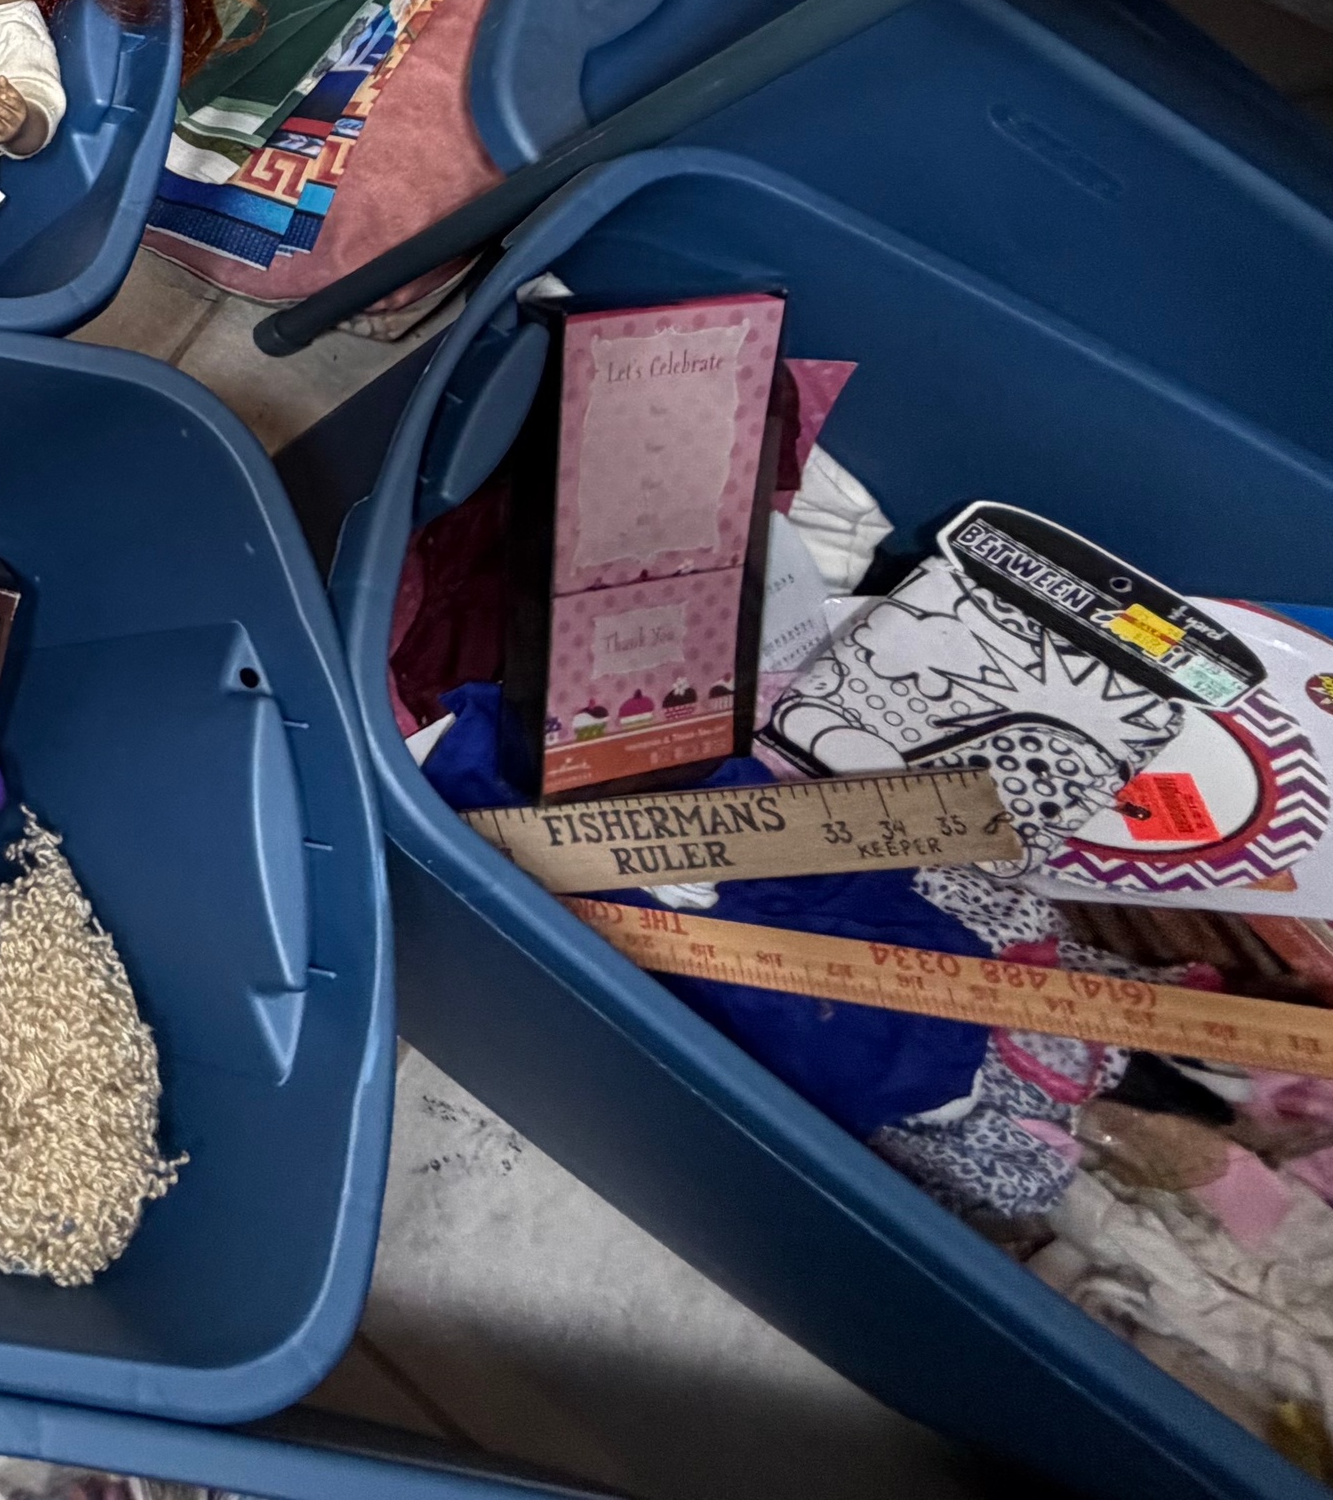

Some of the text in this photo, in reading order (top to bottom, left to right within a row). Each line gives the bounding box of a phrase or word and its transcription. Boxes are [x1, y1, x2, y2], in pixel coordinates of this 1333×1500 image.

[607, 349, 725, 383] Let's Celebrate
[957, 522, 1095, 612] BETWEEN
[605, 626, 675, 651] Thank You
[542, 793, 788, 848] FISHERMAN'S
[822, 814, 969, 845] 33 34 35
[611, 841, 736, 876] RULER
[856, 836, 944, 859] KEEPER
[640, 911, 688, 937] THE
[869, 940, 1158, 1008] (614) 488 0334
